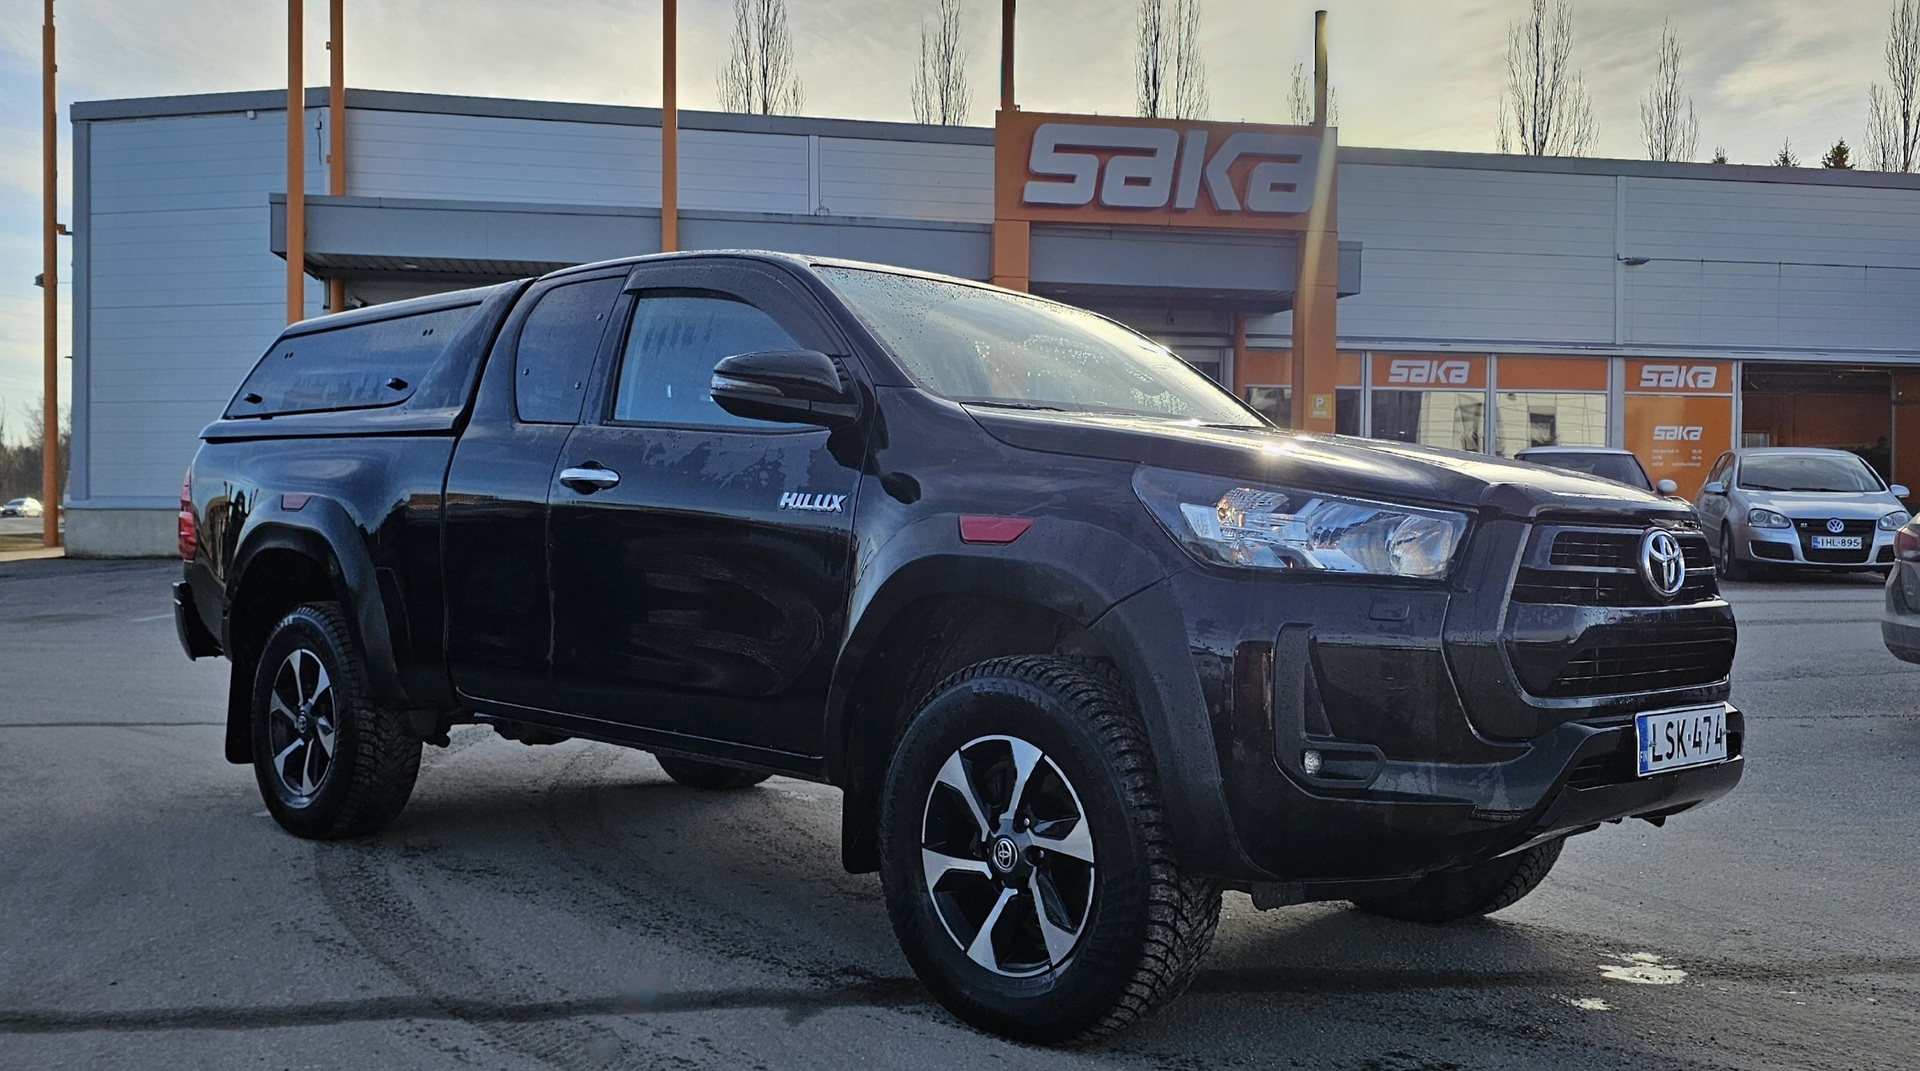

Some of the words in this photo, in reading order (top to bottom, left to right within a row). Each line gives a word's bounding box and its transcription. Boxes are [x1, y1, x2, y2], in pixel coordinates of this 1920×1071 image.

[780, 492, 847, 512] HILUX
[1821, 538, 1860, 547] IHL-895
[1651, 714, 1723, 763] LSK-474
